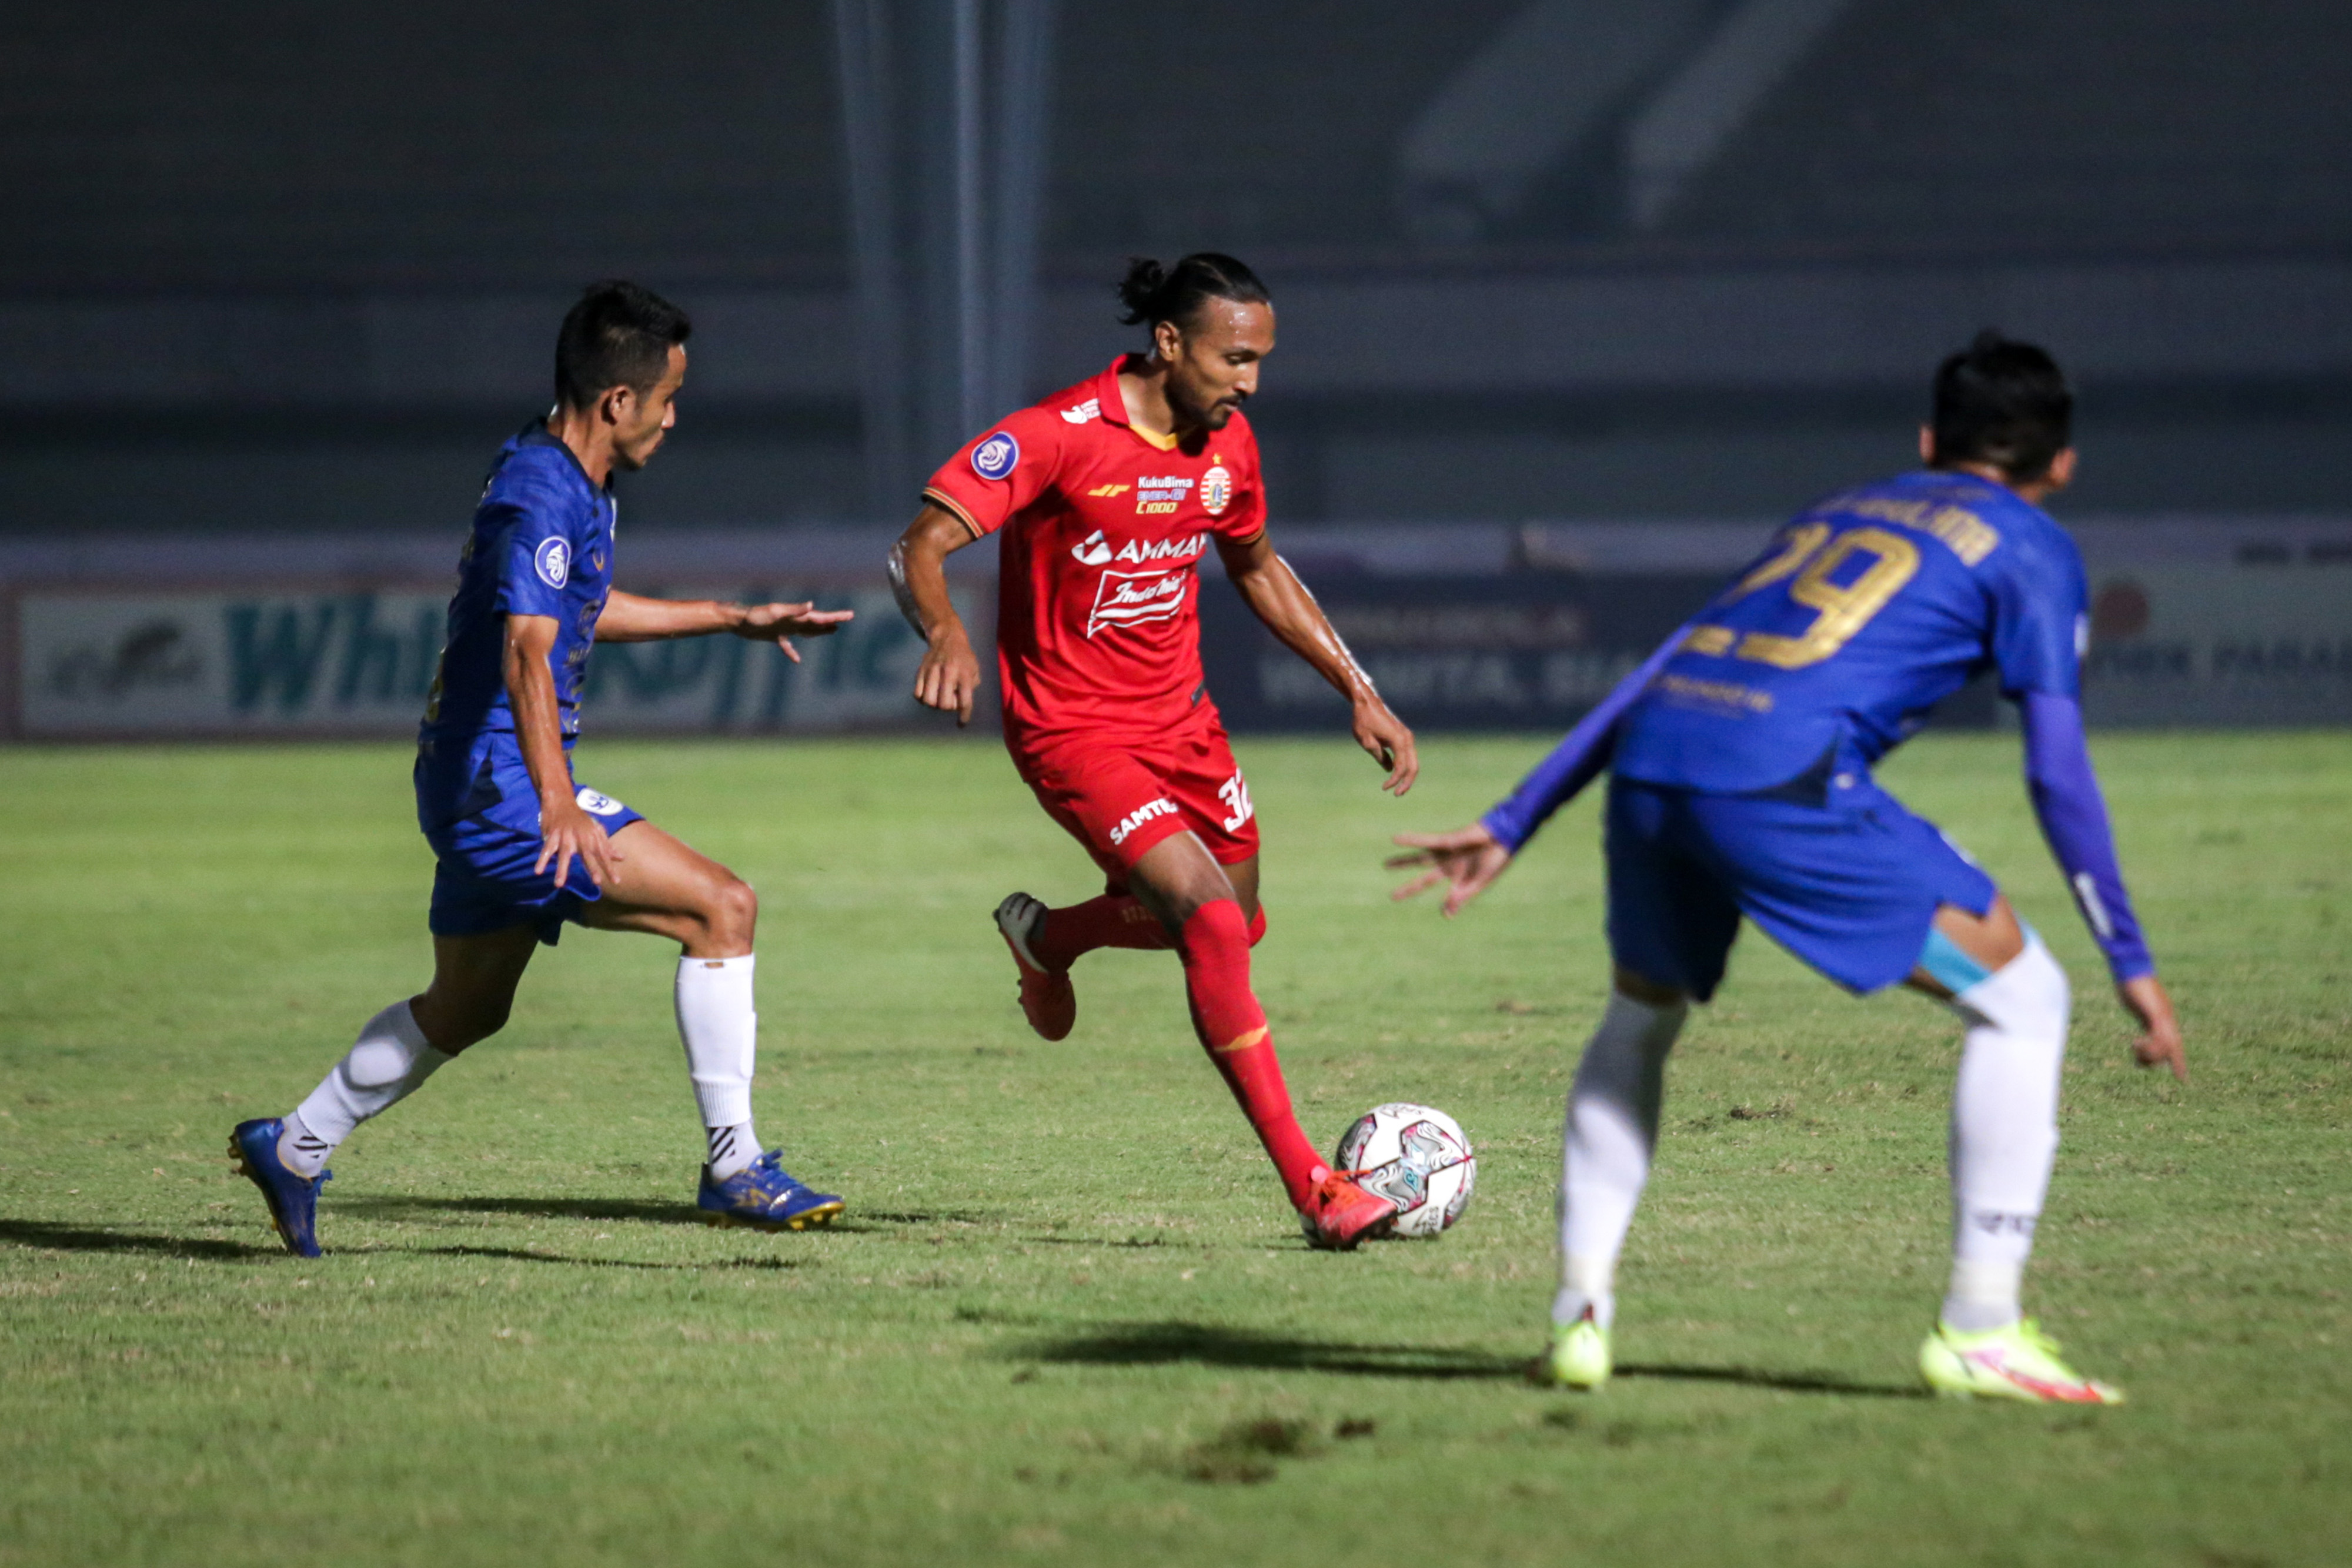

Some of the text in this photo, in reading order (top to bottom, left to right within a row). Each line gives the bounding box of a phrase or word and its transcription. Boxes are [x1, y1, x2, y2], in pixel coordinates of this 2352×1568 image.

[1138, 476, 1195, 489] KukuBima
[1135, 501, 1178, 514] C1000
[1676, 521, 1921, 669] 29
